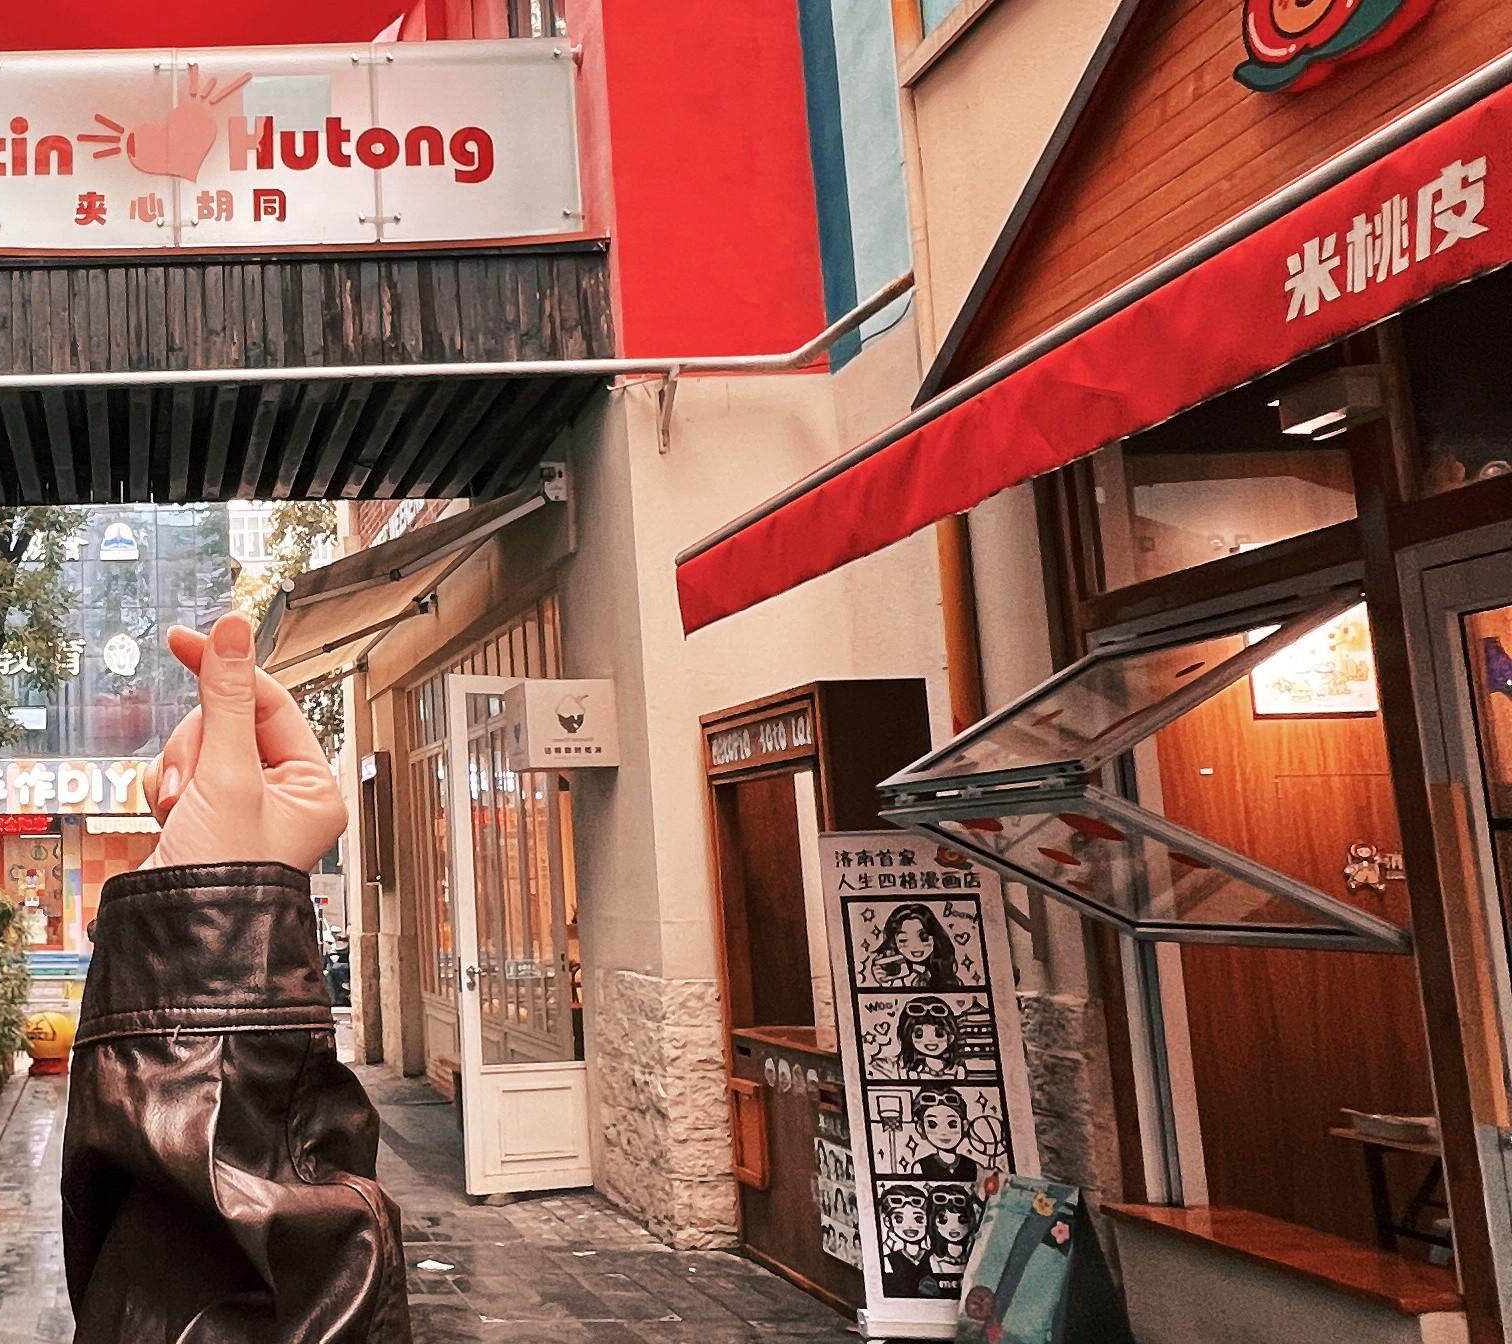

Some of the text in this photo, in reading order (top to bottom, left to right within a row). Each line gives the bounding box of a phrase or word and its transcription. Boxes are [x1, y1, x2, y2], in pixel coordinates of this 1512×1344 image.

[229, 115, 494, 184] Hutong
[74, 189, 287, 225] 夹心胡同
[1284, 155, 1489, 323] 米桃皮
[834, 848, 918, 868] 济南首家
[838, 870, 982, 891] 人生四格漫画店
